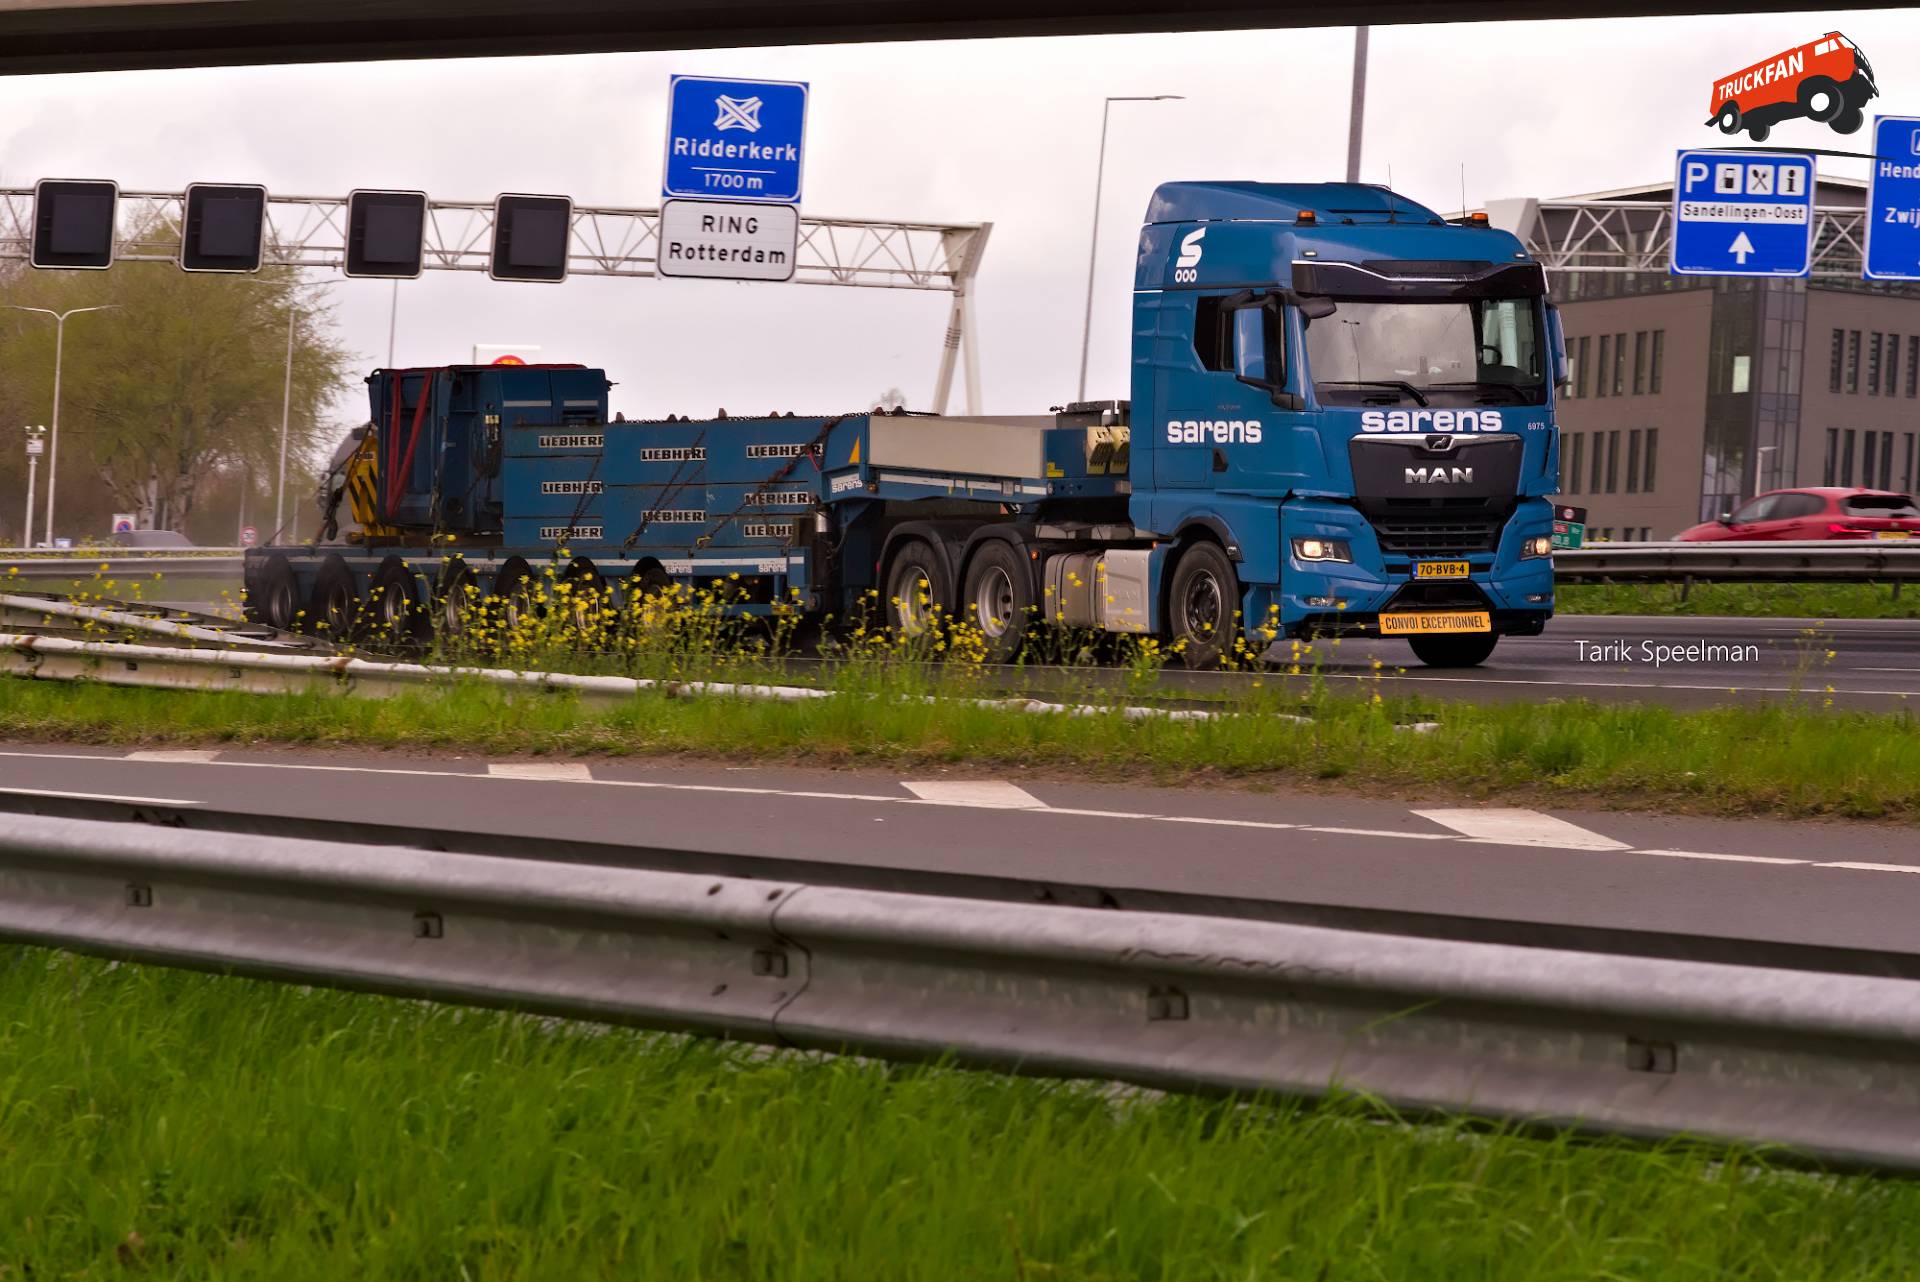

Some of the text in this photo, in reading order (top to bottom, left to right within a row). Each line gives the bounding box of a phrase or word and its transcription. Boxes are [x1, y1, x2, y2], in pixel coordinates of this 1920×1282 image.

[673, 137, 797, 162] Ridderkerk
[704, 173, 763, 190] 1700 m
[1685, 162, 1709, 193] P
[1683, 203, 1804, 221] Sandelingen-Oost
[701, 214, 759, 234] RING
[668, 242, 786, 264] Rotterdam
[1360, 410, 1503, 433] sarens
[1167, 420, 1262, 444] sarens
[747, 445, 823, 457] LIEBHER
[1405, 467, 1474, 484] MAN
[543, 482, 603, 493] LIEBHER
[831, 479, 864, 494] sarens
[642, 511, 706, 522] LIEBHER
[1419, 564, 1465, 575] 70-BVB-4
[1385, 615, 1485, 630] CONVOI EXCEPTIONNEL
